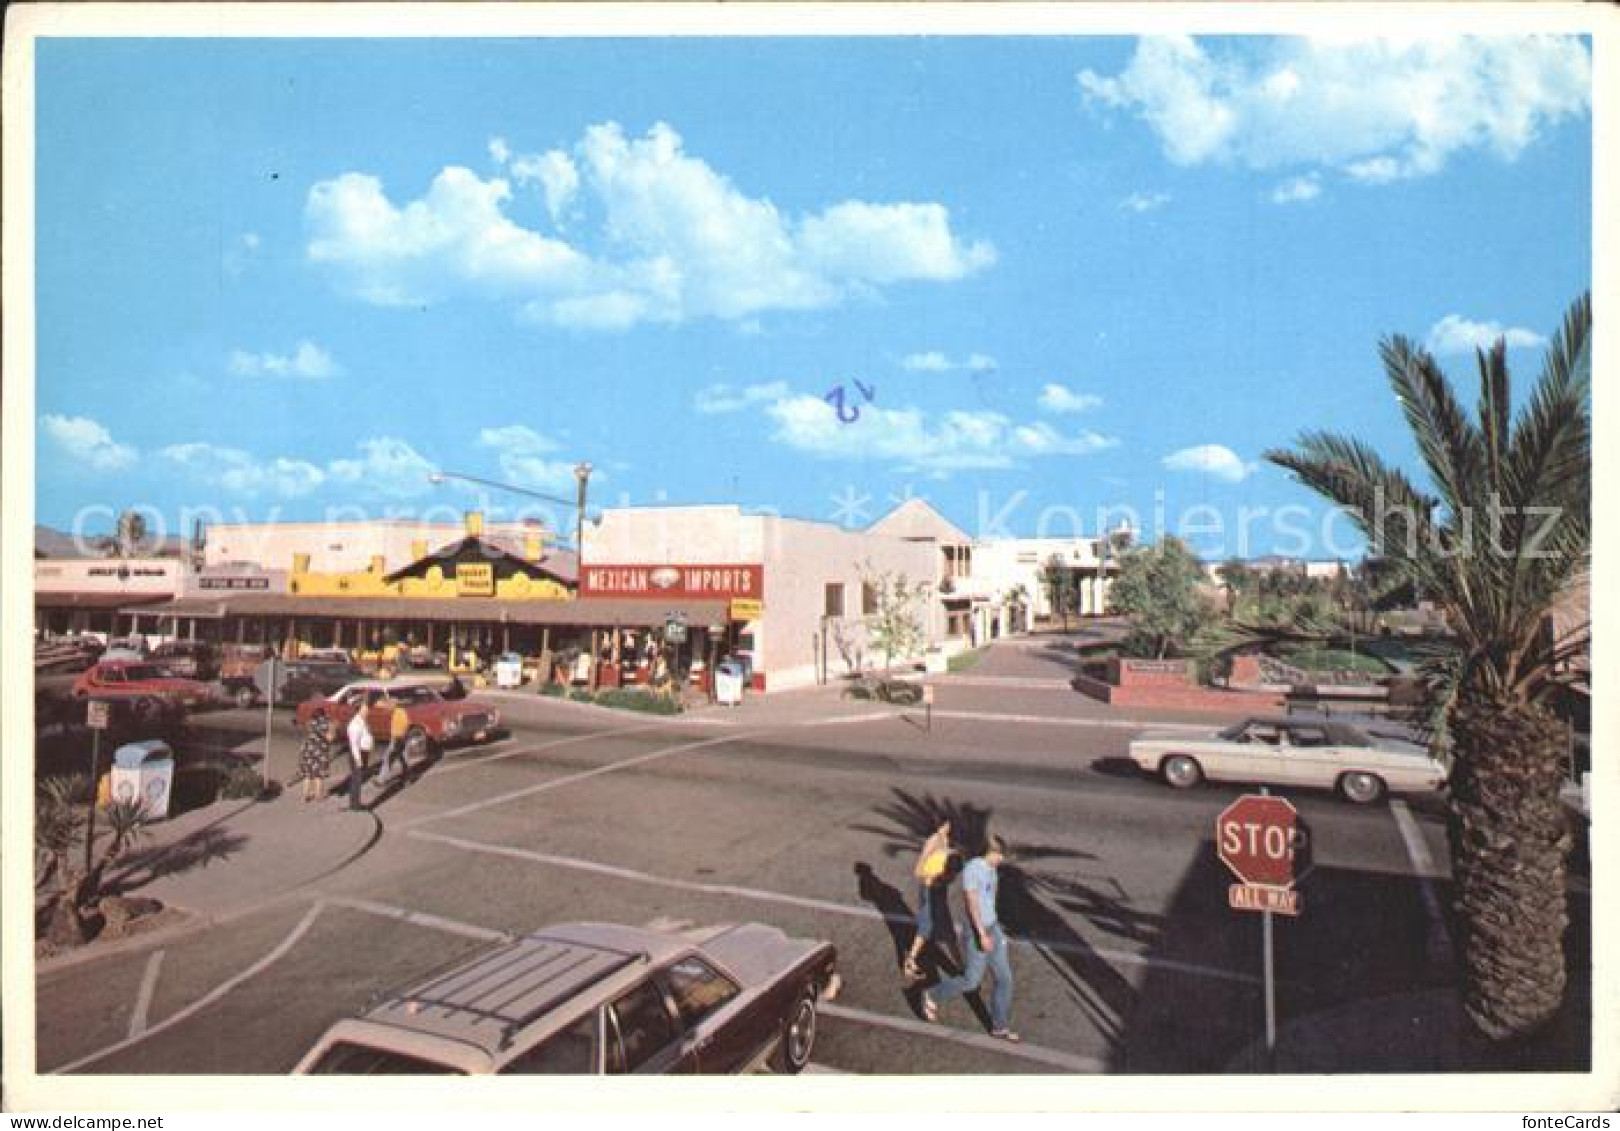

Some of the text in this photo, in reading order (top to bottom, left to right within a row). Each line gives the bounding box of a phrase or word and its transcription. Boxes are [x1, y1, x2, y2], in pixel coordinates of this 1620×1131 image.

[588, 568, 751, 592] MEXICAN IMPORTS
[1223, 821, 1306, 861] STOP
